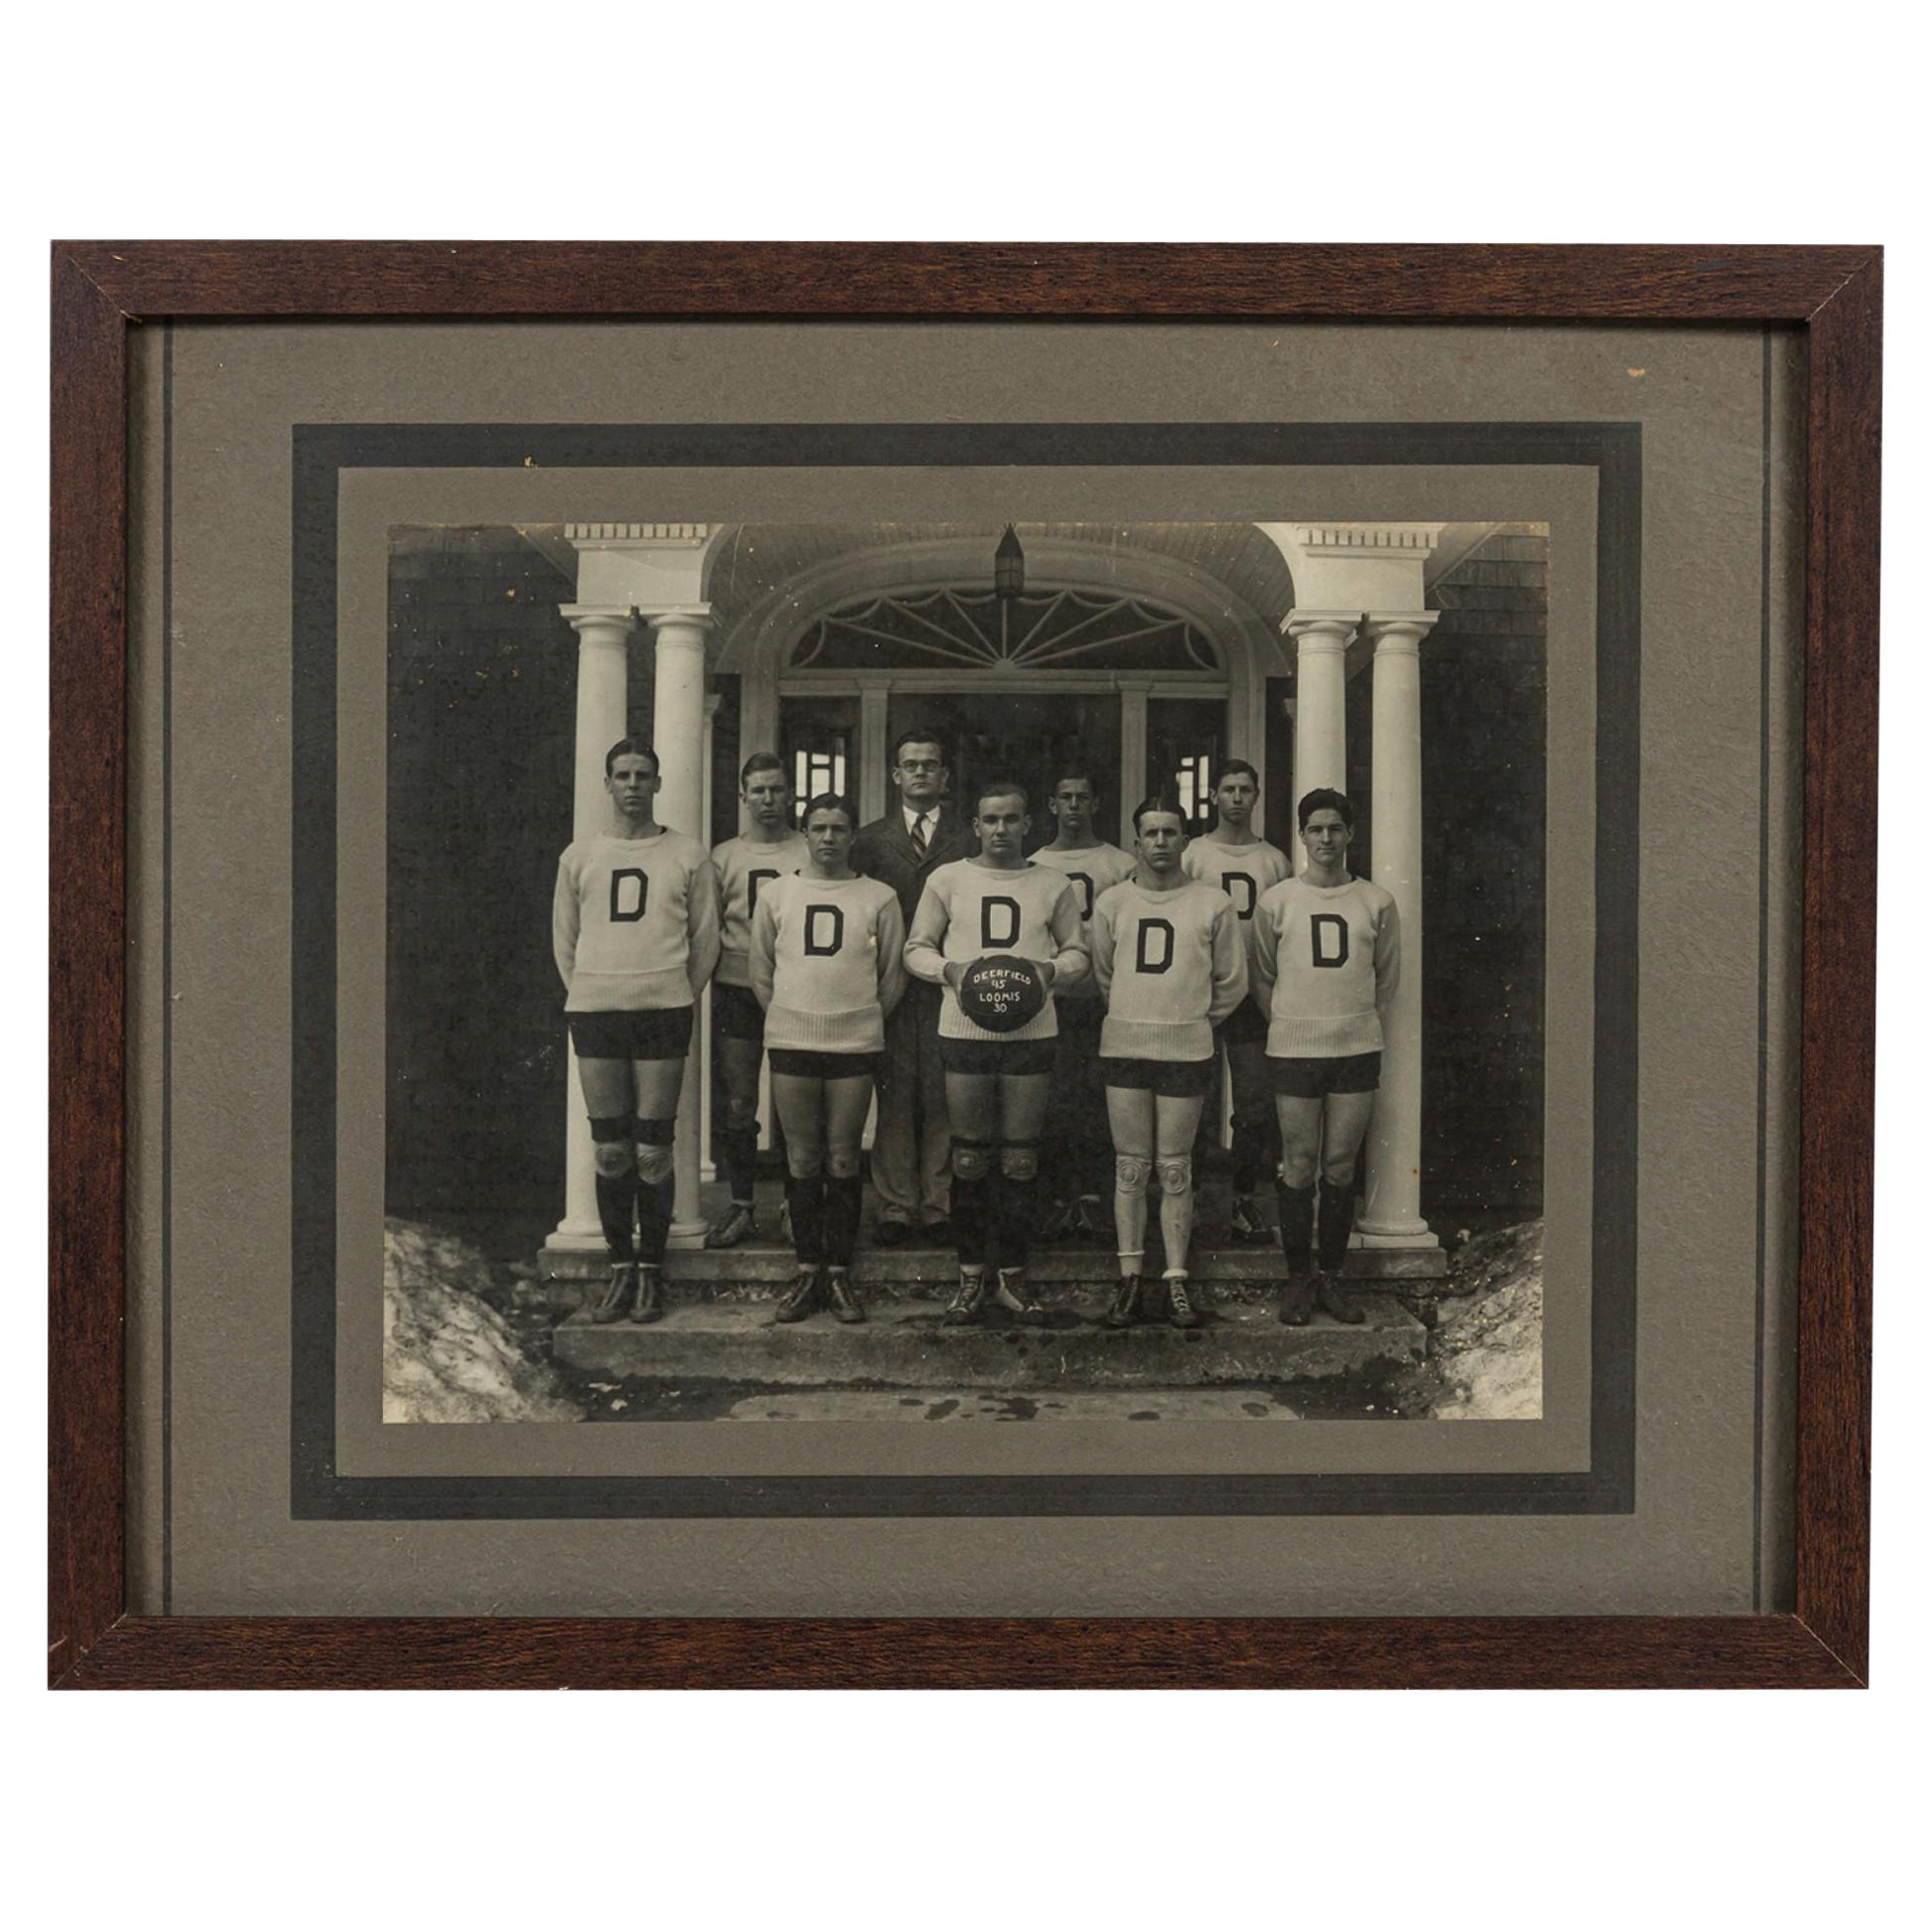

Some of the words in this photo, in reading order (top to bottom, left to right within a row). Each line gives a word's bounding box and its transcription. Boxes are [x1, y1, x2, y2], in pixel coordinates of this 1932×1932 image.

[610, 868, 648, 922] D
[1221, 871, 1257, 920] D
[804, 904, 844, 957] D
[981, 896, 1021, 949] D
[1136, 917, 1174, 974] D
[1311, 913, 1349, 969] D
[973, 969, 1032, 985] DEERFIELD
[979, 992, 1022, 1003] LOOMIS
[991, 979, 1007, 989] 45
[993, 1003, 1008, 1013] 30
